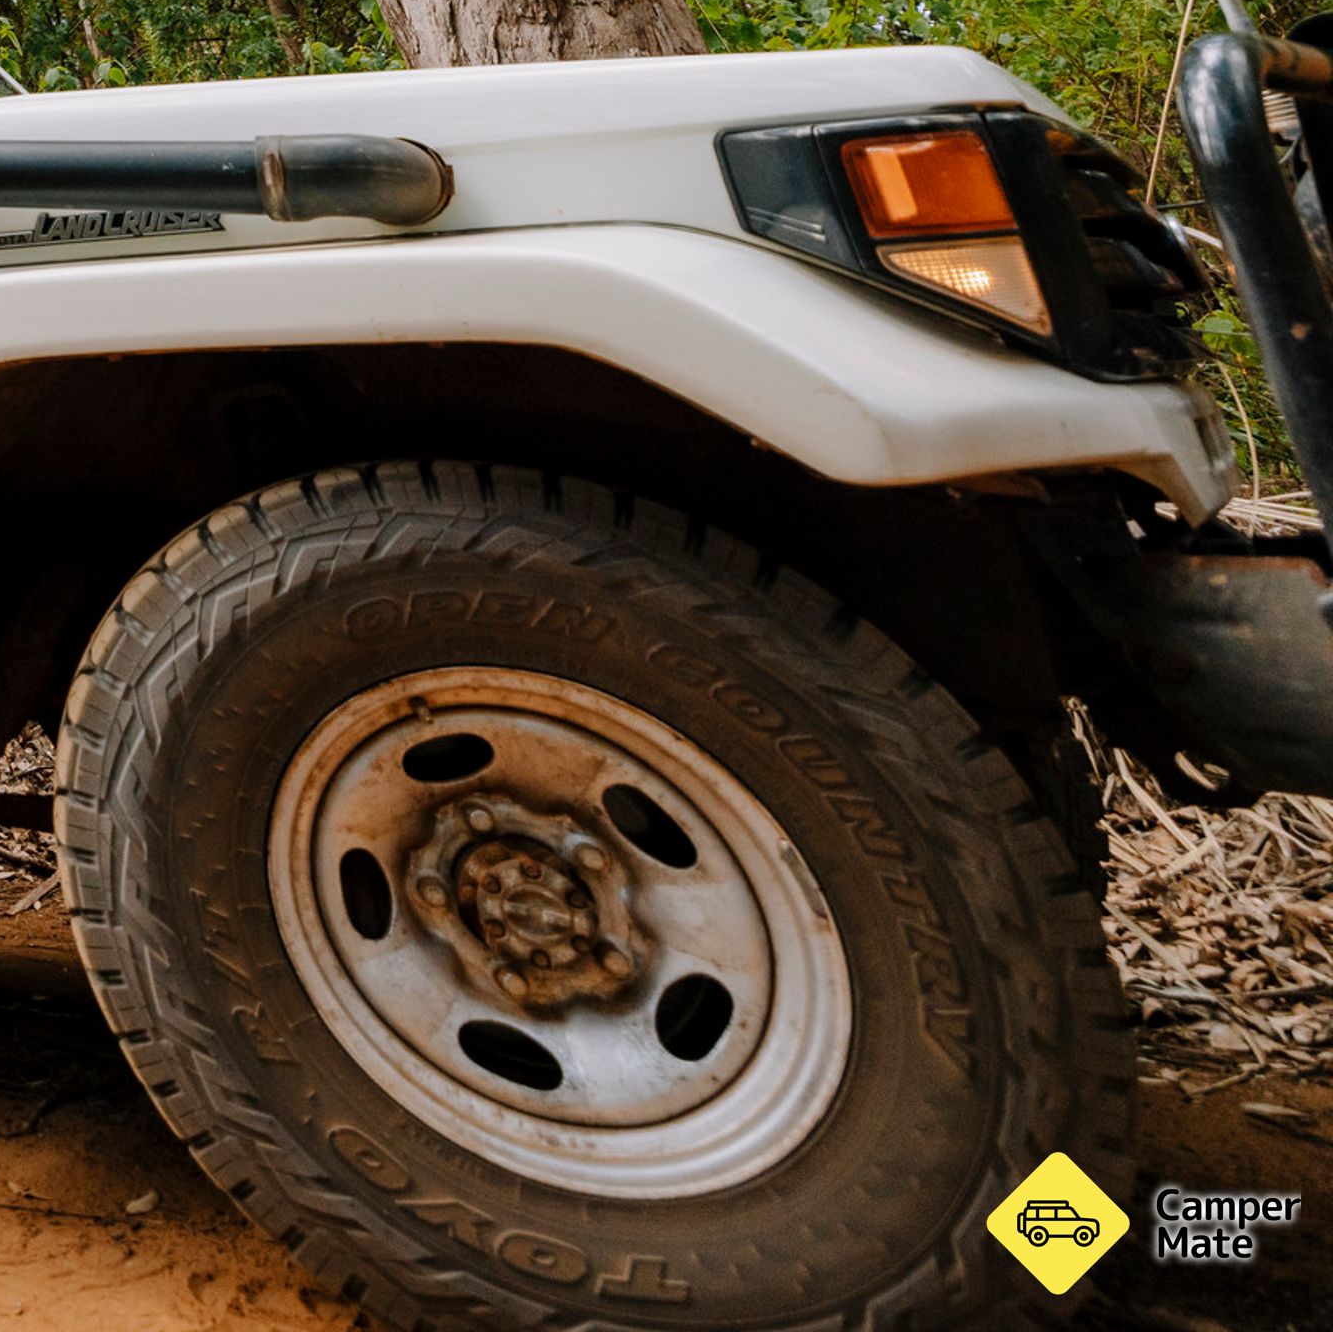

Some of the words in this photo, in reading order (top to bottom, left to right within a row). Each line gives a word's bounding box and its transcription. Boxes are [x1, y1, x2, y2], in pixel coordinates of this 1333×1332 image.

[341, 588, 617, 644] OPEN
[643, 641, 974, 1083] COUNTRY
[327, 1125, 691, 1304] TOYO
